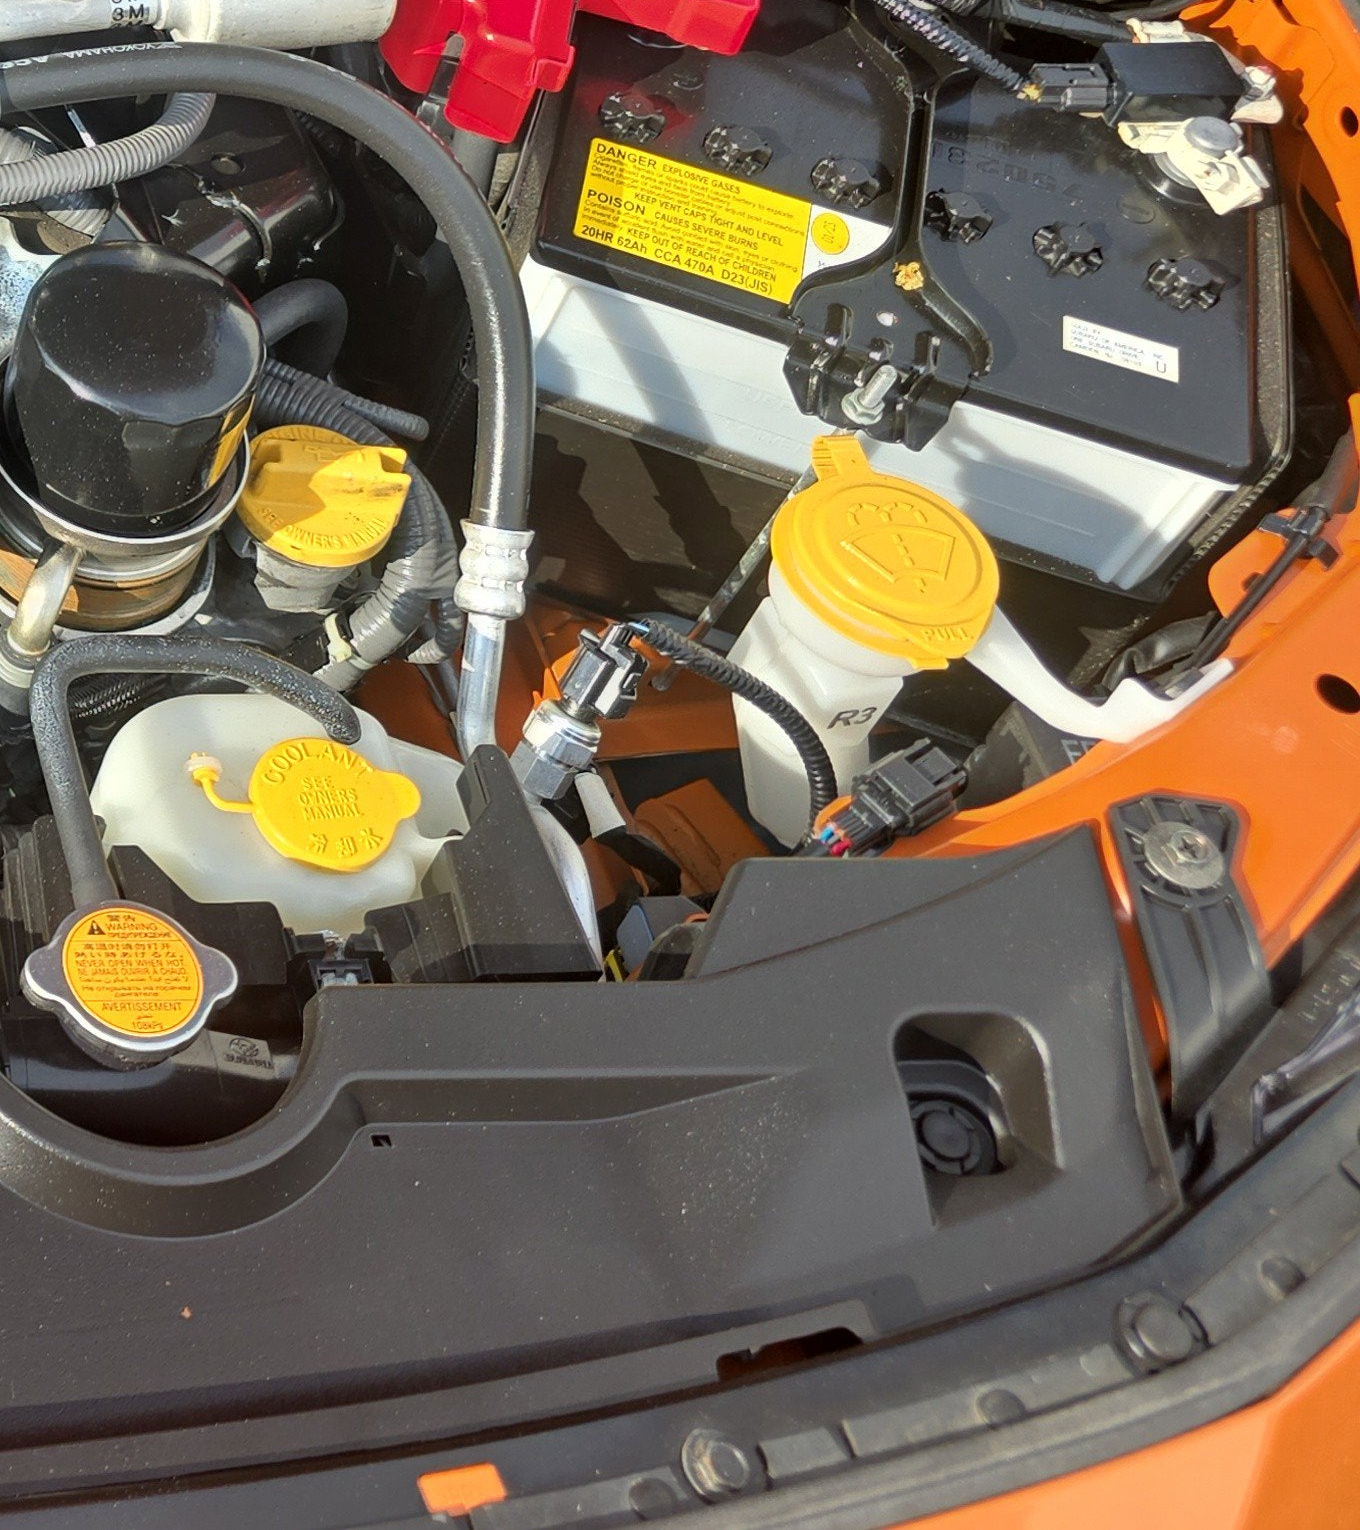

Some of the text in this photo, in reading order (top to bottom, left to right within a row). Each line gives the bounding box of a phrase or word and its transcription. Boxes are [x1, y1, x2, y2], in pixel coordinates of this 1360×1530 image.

[595, 142, 741, 196] DANGER EXPLOSIVE GASES
[586, 188, 759, 252] POISON CAUSES SEVERE BURNS
[633, 191, 657, 206] KEEP
[657, 199, 681, 213] VENT
[682, 206, 707, 222] CAPS
[734, 223, 755, 237] AND
[755, 229, 784, 246] LEVEL
[580, 223, 774, 296] 20HR 62Ah CCA 470A D23(JIS)
[626, 226, 777, 282] KEEP OUT OF REACH OF CHILDREN
[920, 626, 974, 642] PULL
[826, 706, 878, 730] R3
[261, 741, 373, 786] COOLANT
[301, 775, 334, 790] SEE
[301, 803, 362, 822] MANUAL
[106, 923, 158, 931] WARNING
[76, 960, 105, 968] NEVER
[108, 960, 132, 968] OPEN
[136, 959, 164, 967] WHEN
[101, 1002, 182, 1011] AVERTISSEMENT
